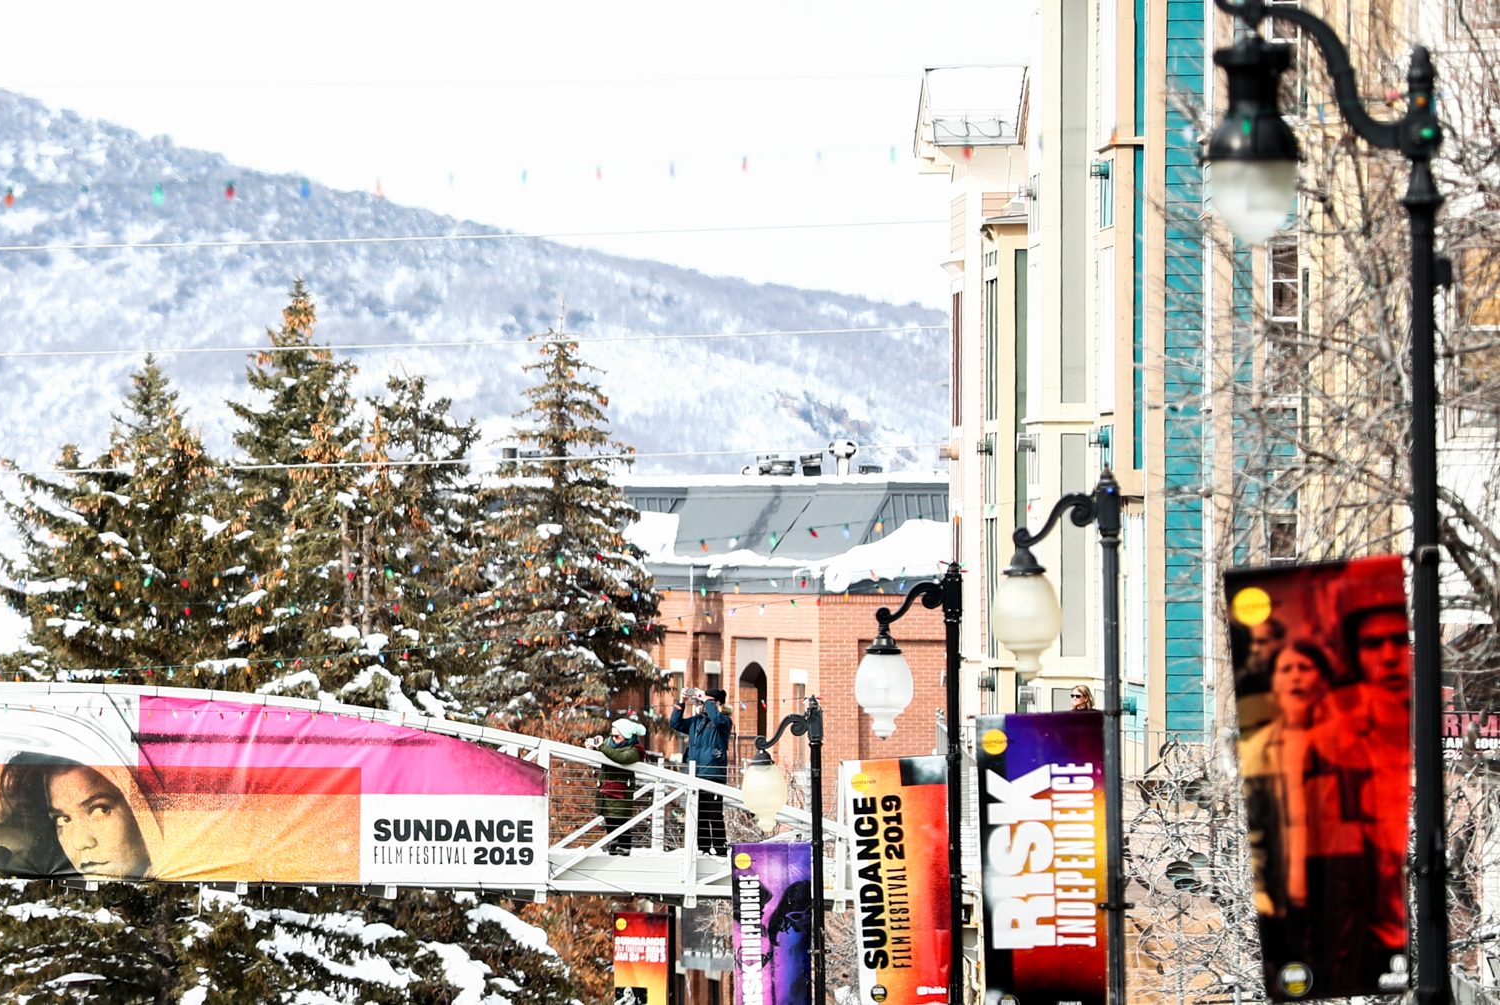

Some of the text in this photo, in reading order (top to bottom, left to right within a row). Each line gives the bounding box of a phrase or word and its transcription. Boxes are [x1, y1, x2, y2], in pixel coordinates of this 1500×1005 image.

[373, 818, 534, 843] SUNDANCE
[374, 845, 534, 866] FILM FESTIVAL 2019
[739, 874, 763, 961] INDEPENDENCE
[853, 796, 890, 970] SUNDANCE
[881, 795, 912, 969] FILM FESTIVAL 2019
[986, 764, 1056, 950] RISK
[1050, 762, 1097, 948] INDEPENDENCE
